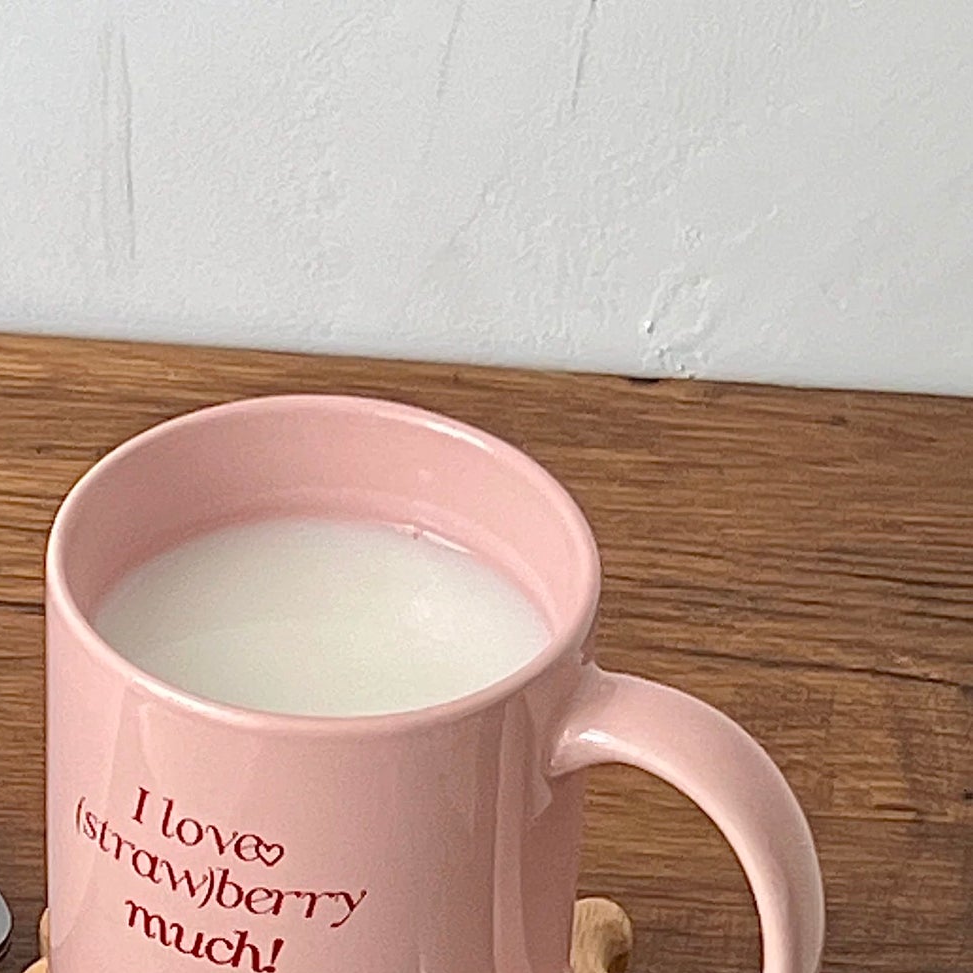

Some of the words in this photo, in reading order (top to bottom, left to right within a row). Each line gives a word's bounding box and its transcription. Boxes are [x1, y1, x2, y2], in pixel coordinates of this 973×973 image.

[132, 786, 150, 824] I
[162, 797, 264, 862] love
[76, 797, 367, 928] (straw)berry
[125, 900, 284, 973] much!
